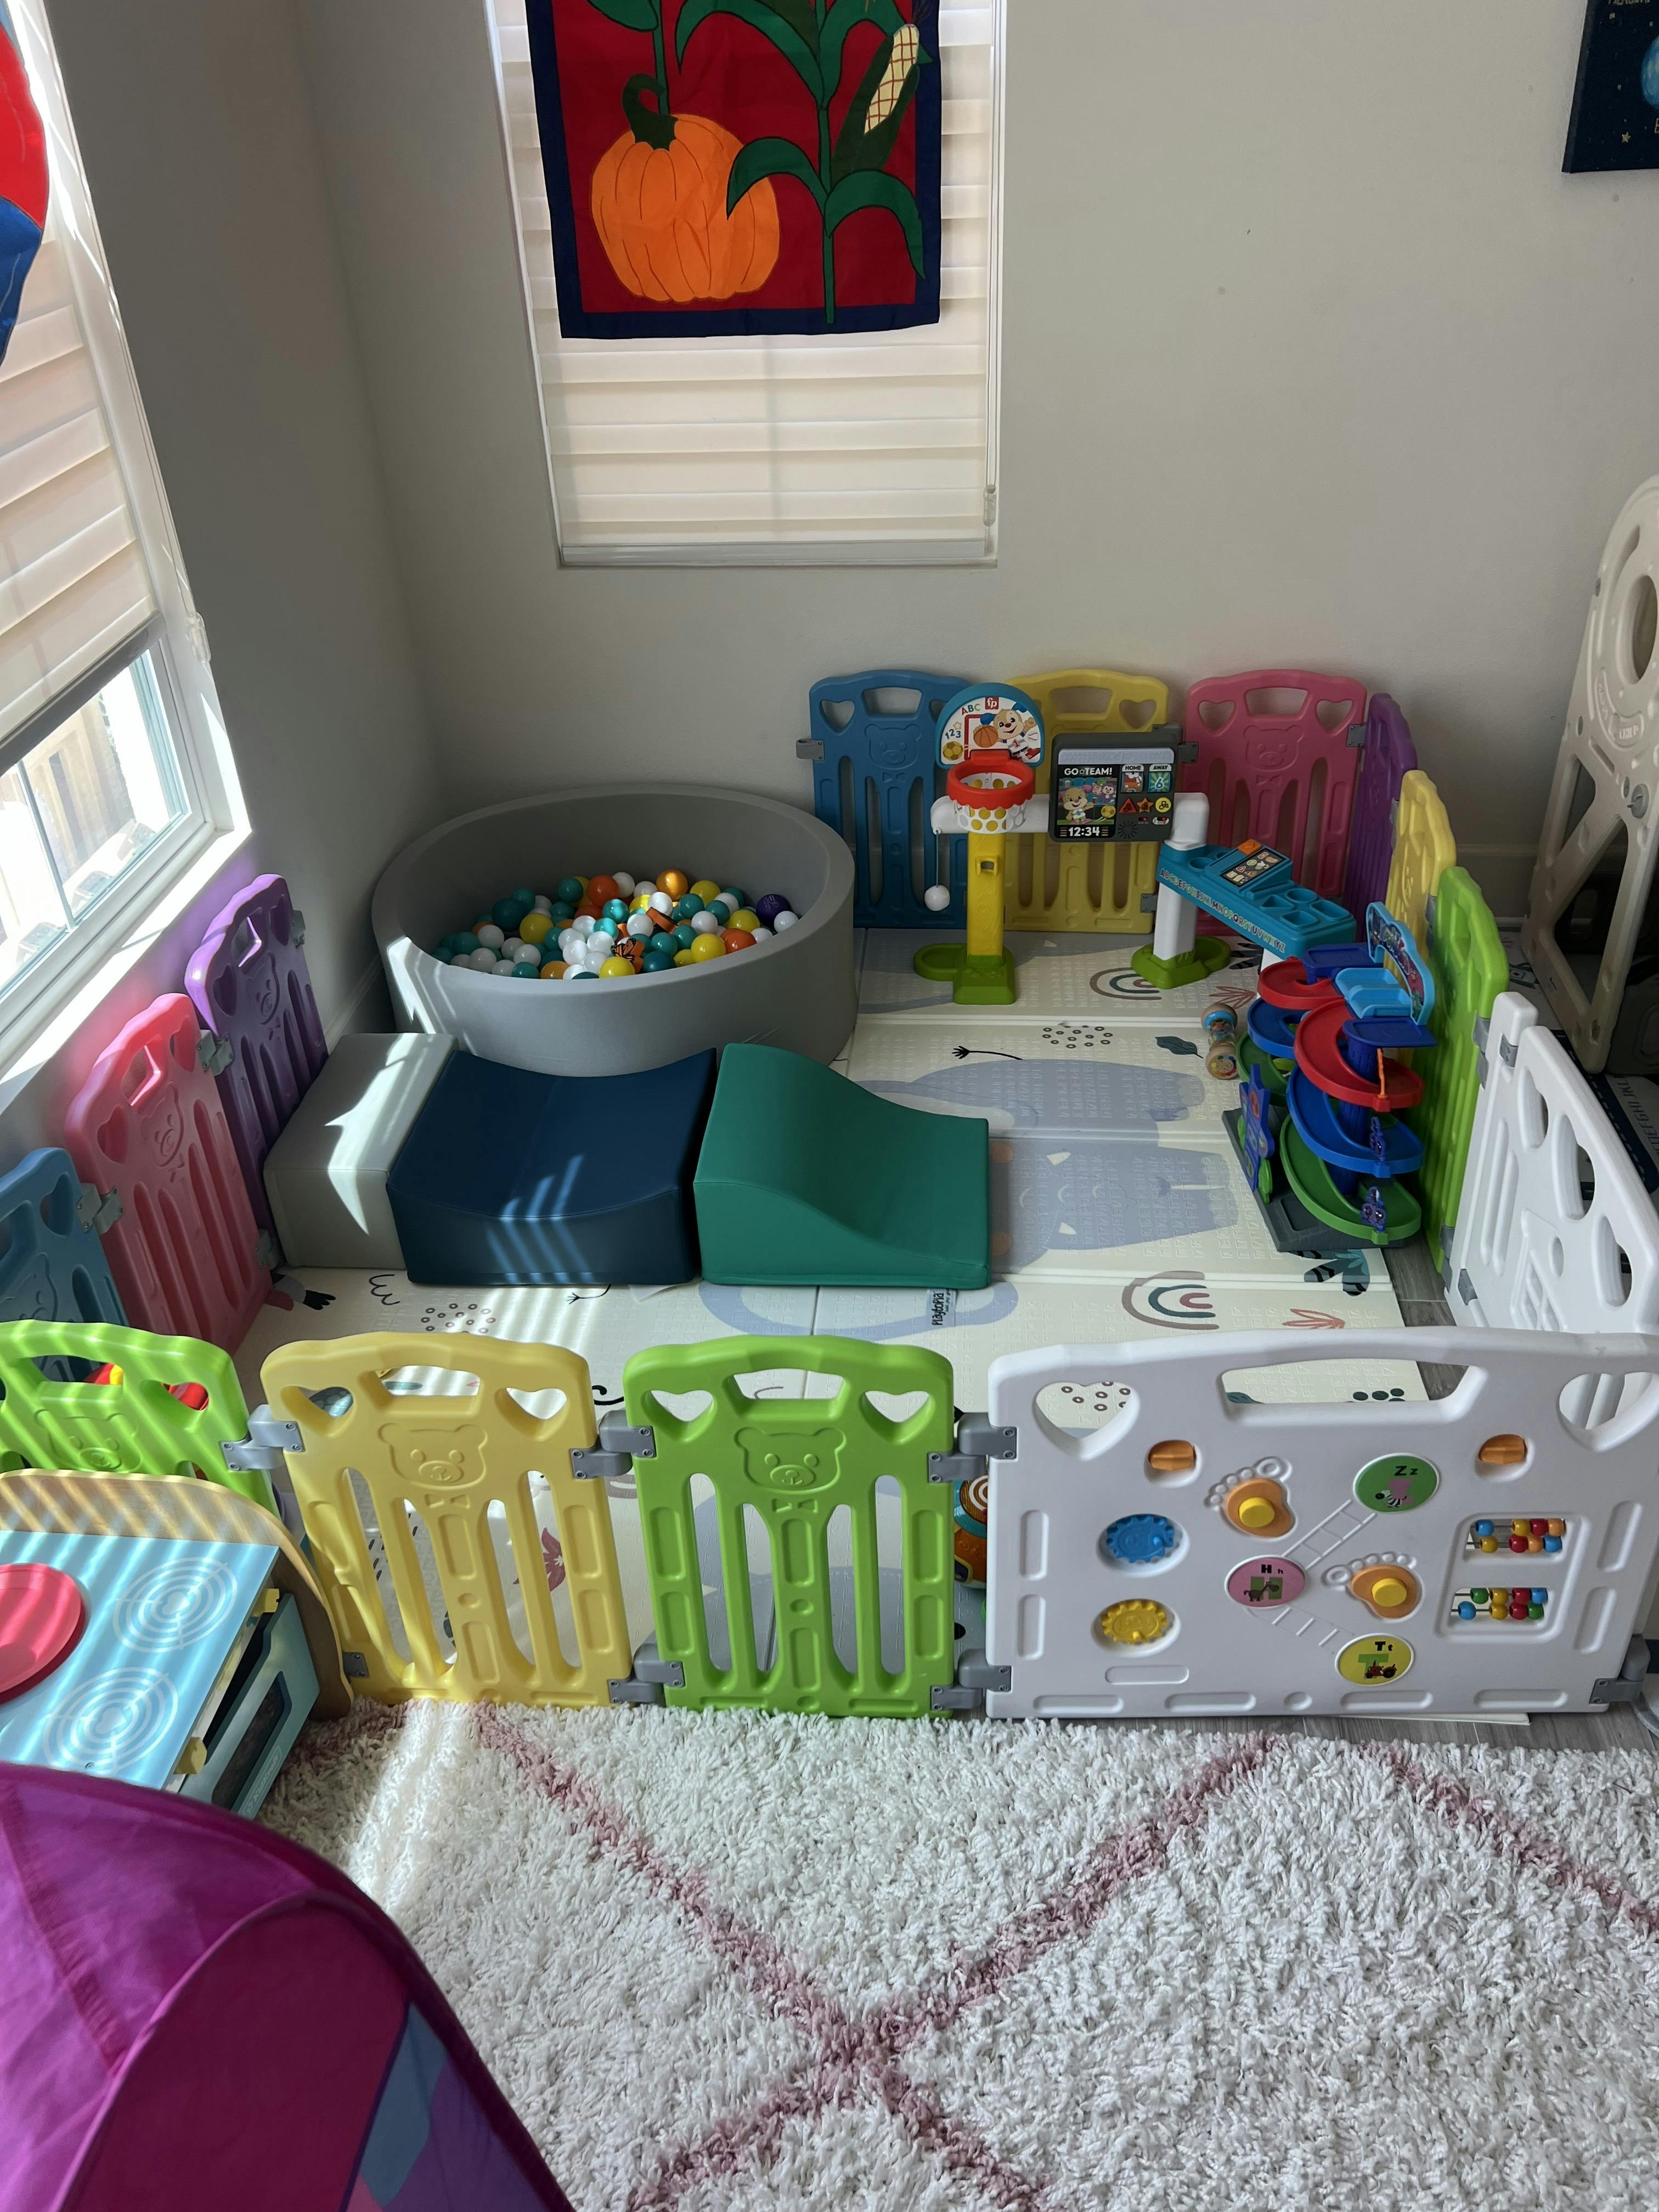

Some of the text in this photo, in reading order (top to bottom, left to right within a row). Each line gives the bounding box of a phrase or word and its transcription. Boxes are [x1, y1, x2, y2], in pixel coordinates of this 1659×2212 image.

[987, 697, 997, 709] fp
[961, 703, 981, 715] ABC
[945, 729, 961, 740] 123
[1064, 768, 1079, 776] GO
[1155, 776, 1164, 789] 6
[1068, 826, 1100, 837] 12:34
[1394, 1465, 1407, 1476] Z
[1261, 1564, 1272, 1574] H
[1375, 1641, 1386, 1651] T
